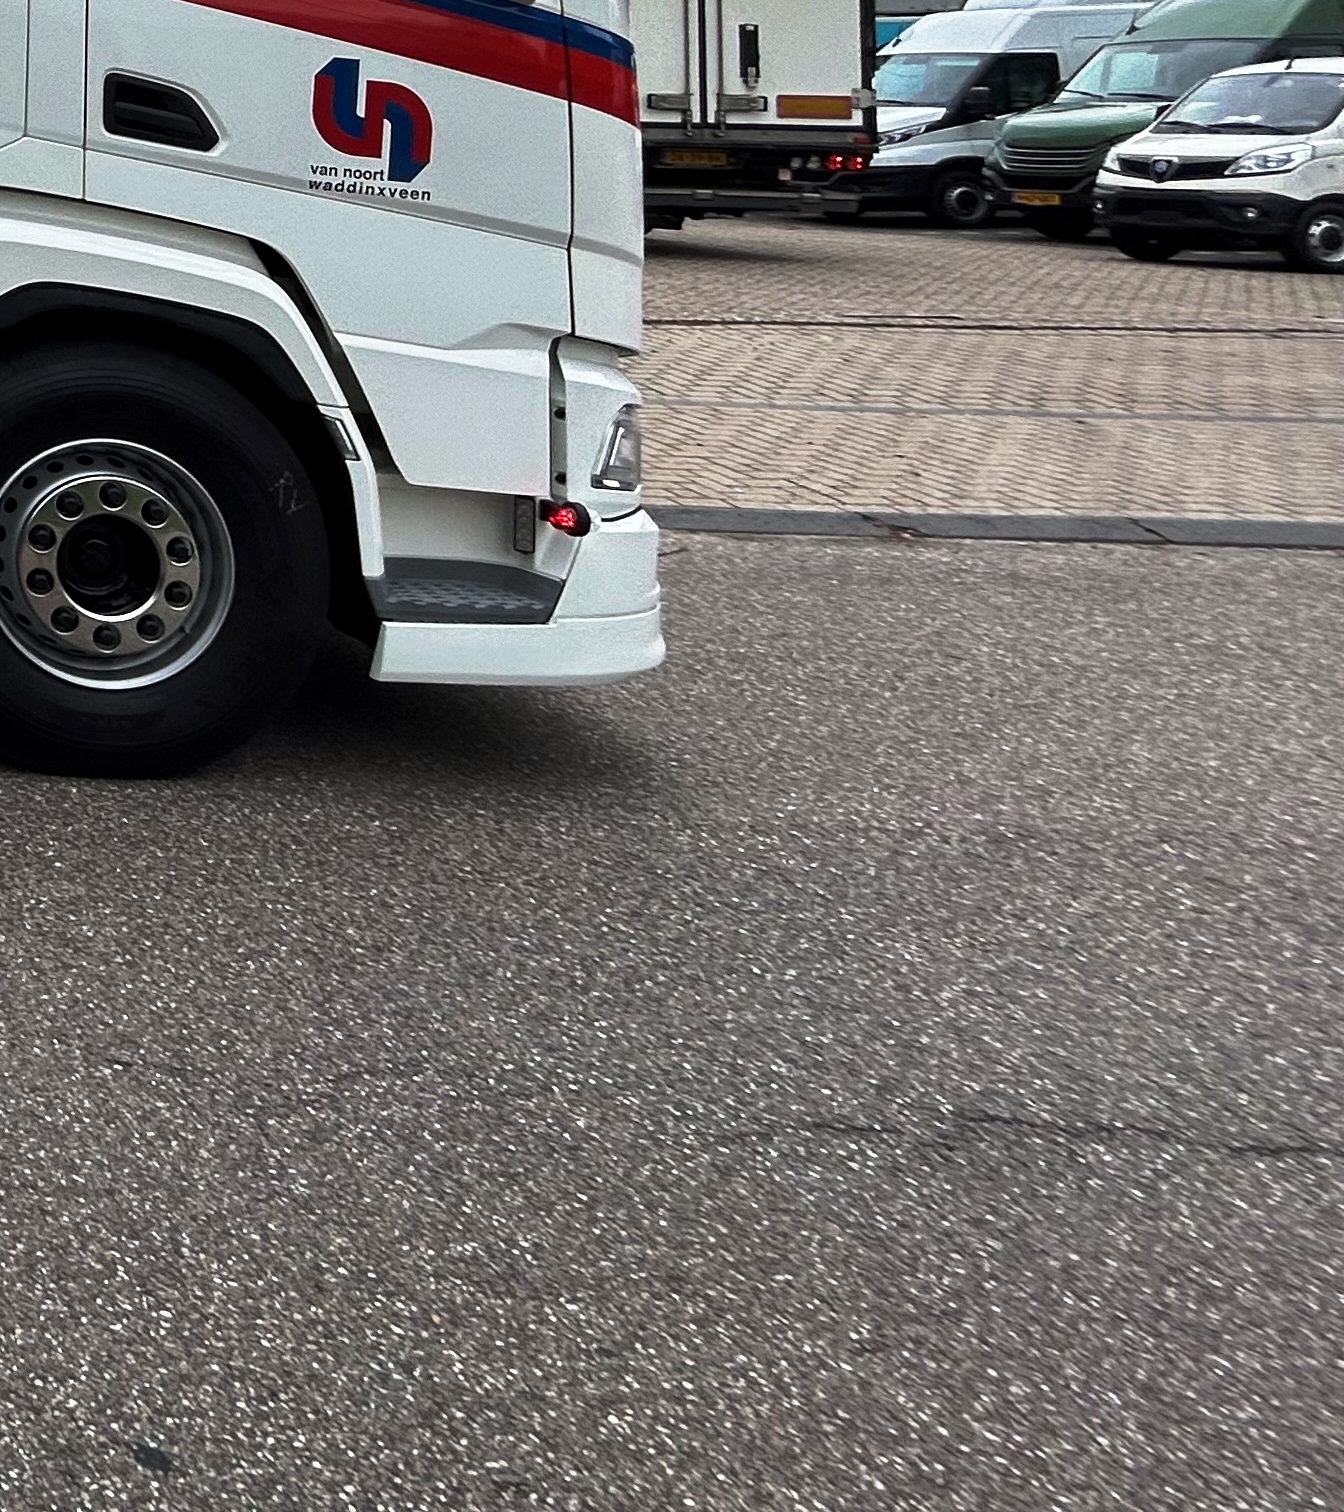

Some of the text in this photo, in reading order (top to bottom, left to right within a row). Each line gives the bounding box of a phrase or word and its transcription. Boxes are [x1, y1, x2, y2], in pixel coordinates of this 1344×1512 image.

[310, 164, 385, 182] van noort
[308, 179, 432, 202] waddinxveen
